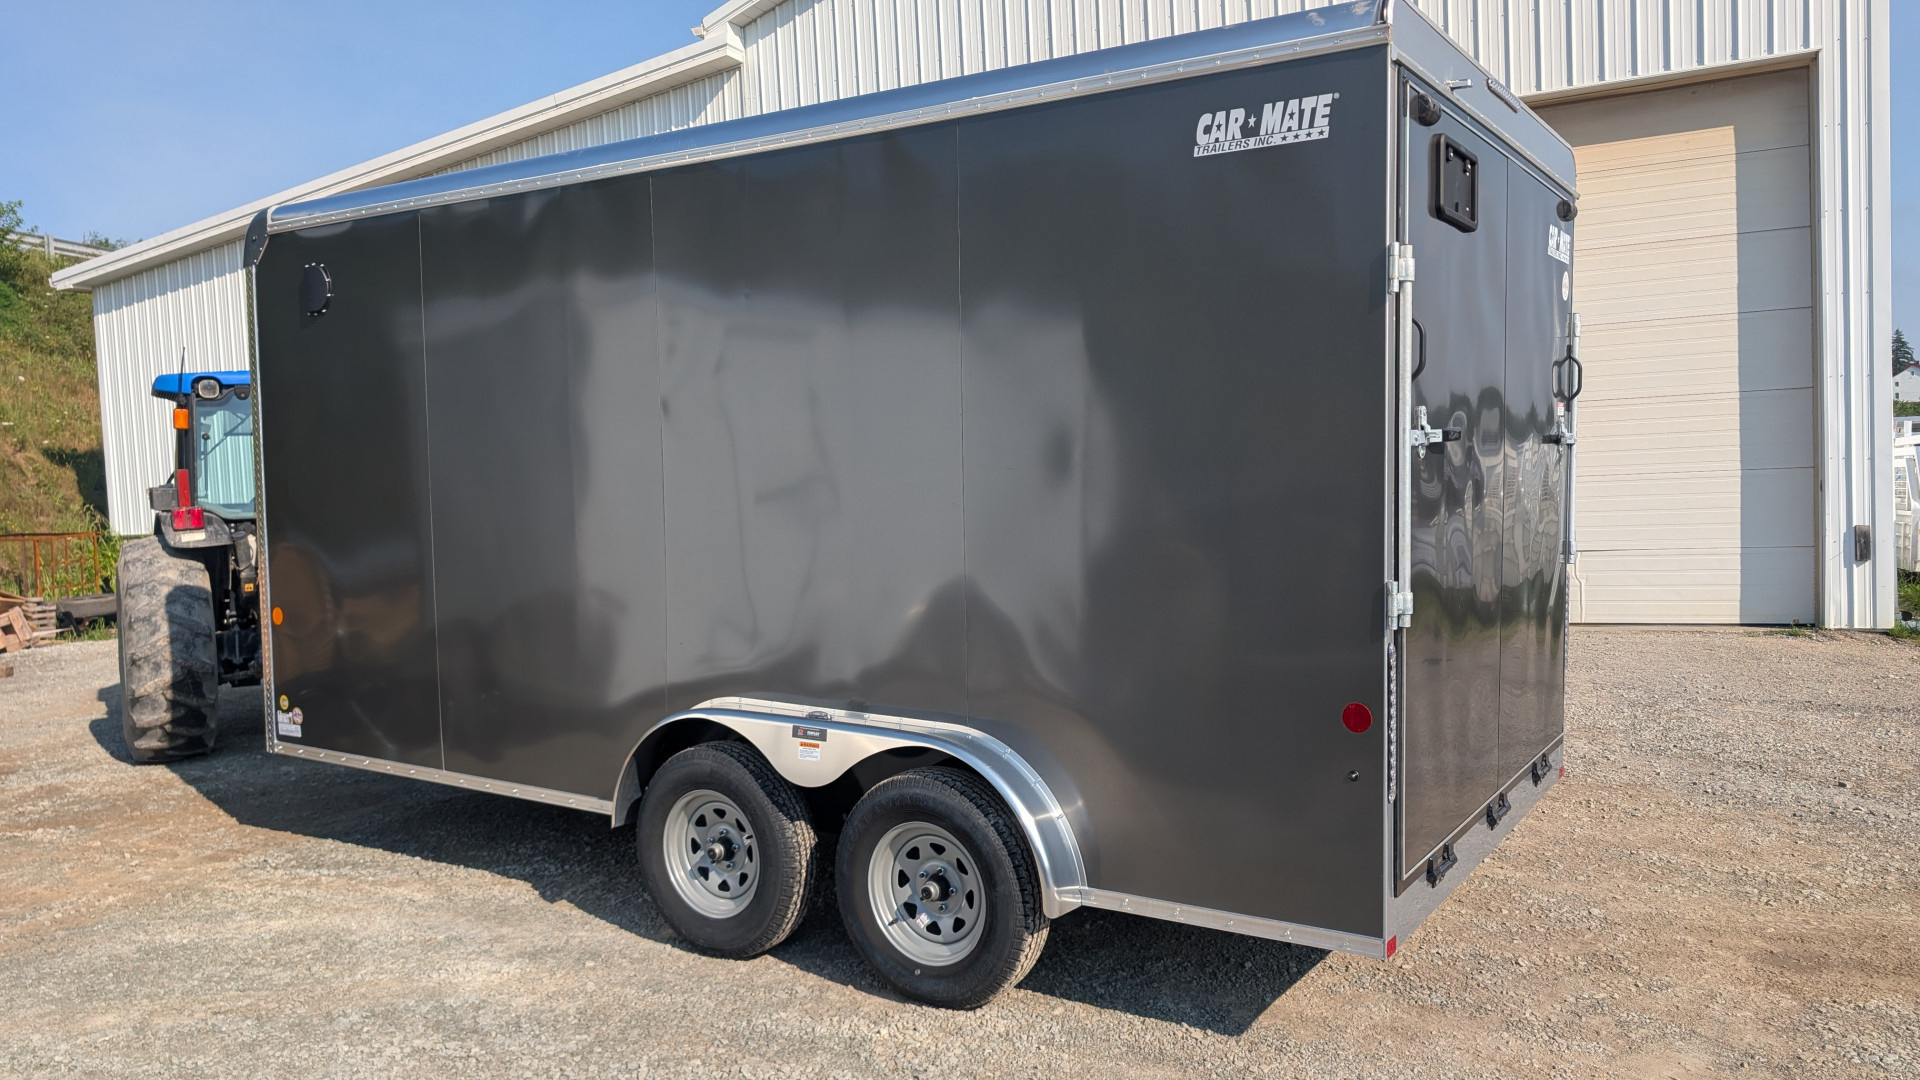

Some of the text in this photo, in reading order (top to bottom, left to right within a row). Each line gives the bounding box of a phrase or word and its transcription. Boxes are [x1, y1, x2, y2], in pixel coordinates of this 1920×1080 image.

[1196, 93, 1333, 145] CAR MATE
[1196, 135, 1277, 155] TRAILERS INC.
